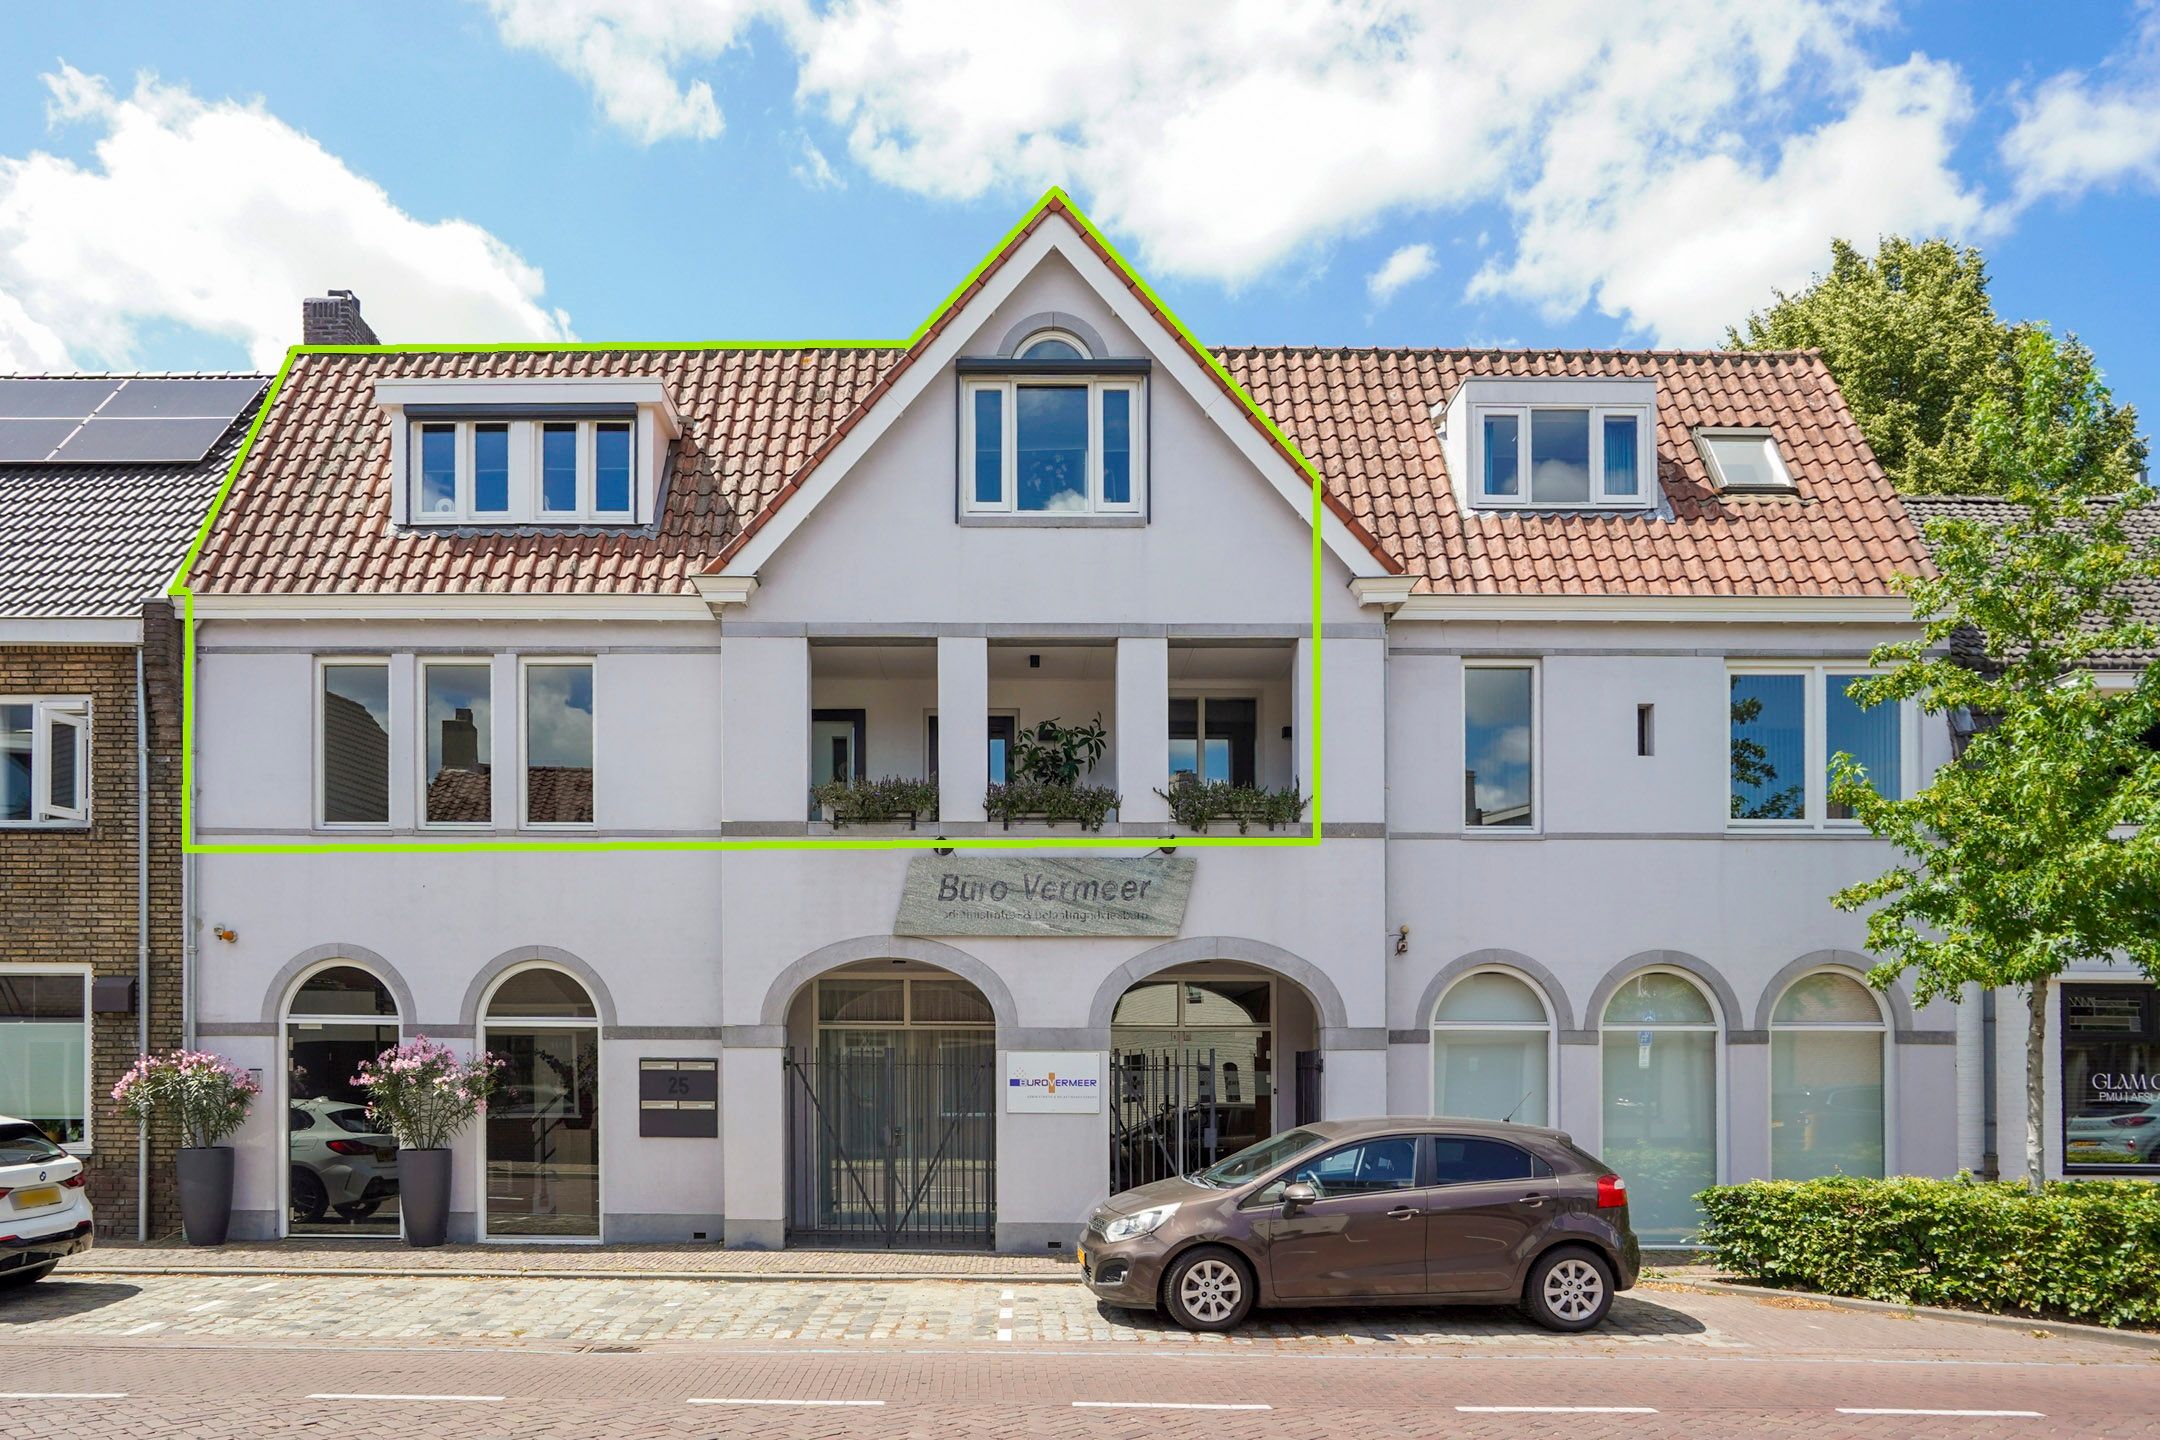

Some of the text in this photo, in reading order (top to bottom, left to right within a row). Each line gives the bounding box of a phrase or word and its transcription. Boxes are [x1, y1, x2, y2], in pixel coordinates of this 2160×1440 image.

[938, 873, 1152, 901] Buro Vermeer
[668, 1076, 689, 1095] 25
[2092, 1073, 2147, 1090] GLAM
[2099, 1091, 2122, 1102] PMU
